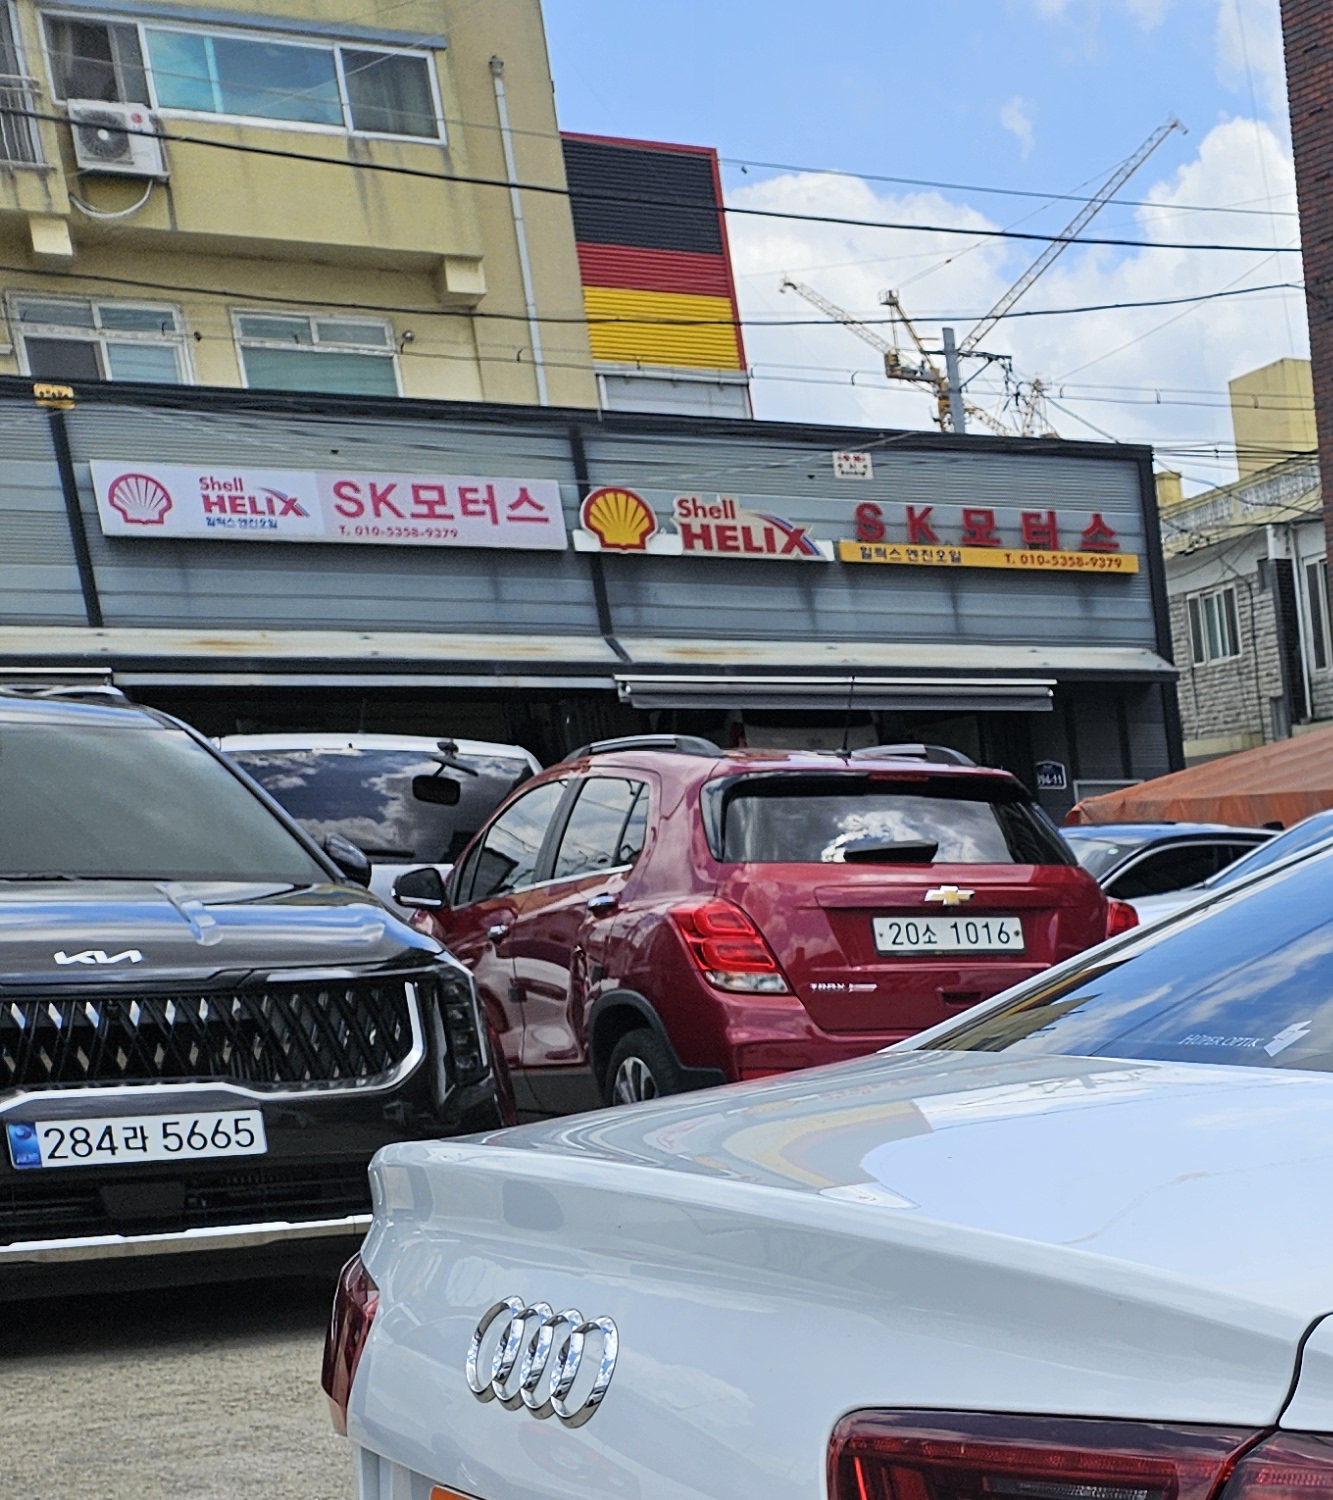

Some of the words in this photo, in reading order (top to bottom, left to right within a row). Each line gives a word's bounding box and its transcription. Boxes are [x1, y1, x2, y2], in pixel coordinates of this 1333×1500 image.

[199, 476, 244, 492] Shell
[201, 493, 307, 518] HELIX
[332, 480, 550, 526] SK모터스
[677, 498, 736, 520] Shell
[680, 522, 817, 556] HELIX
[888, 921, 938, 946] 20소
[950, 920, 1010, 946] 1016
[43, 1124, 149, 1160] 284라
[162, 1117, 255, 1152] 5665
